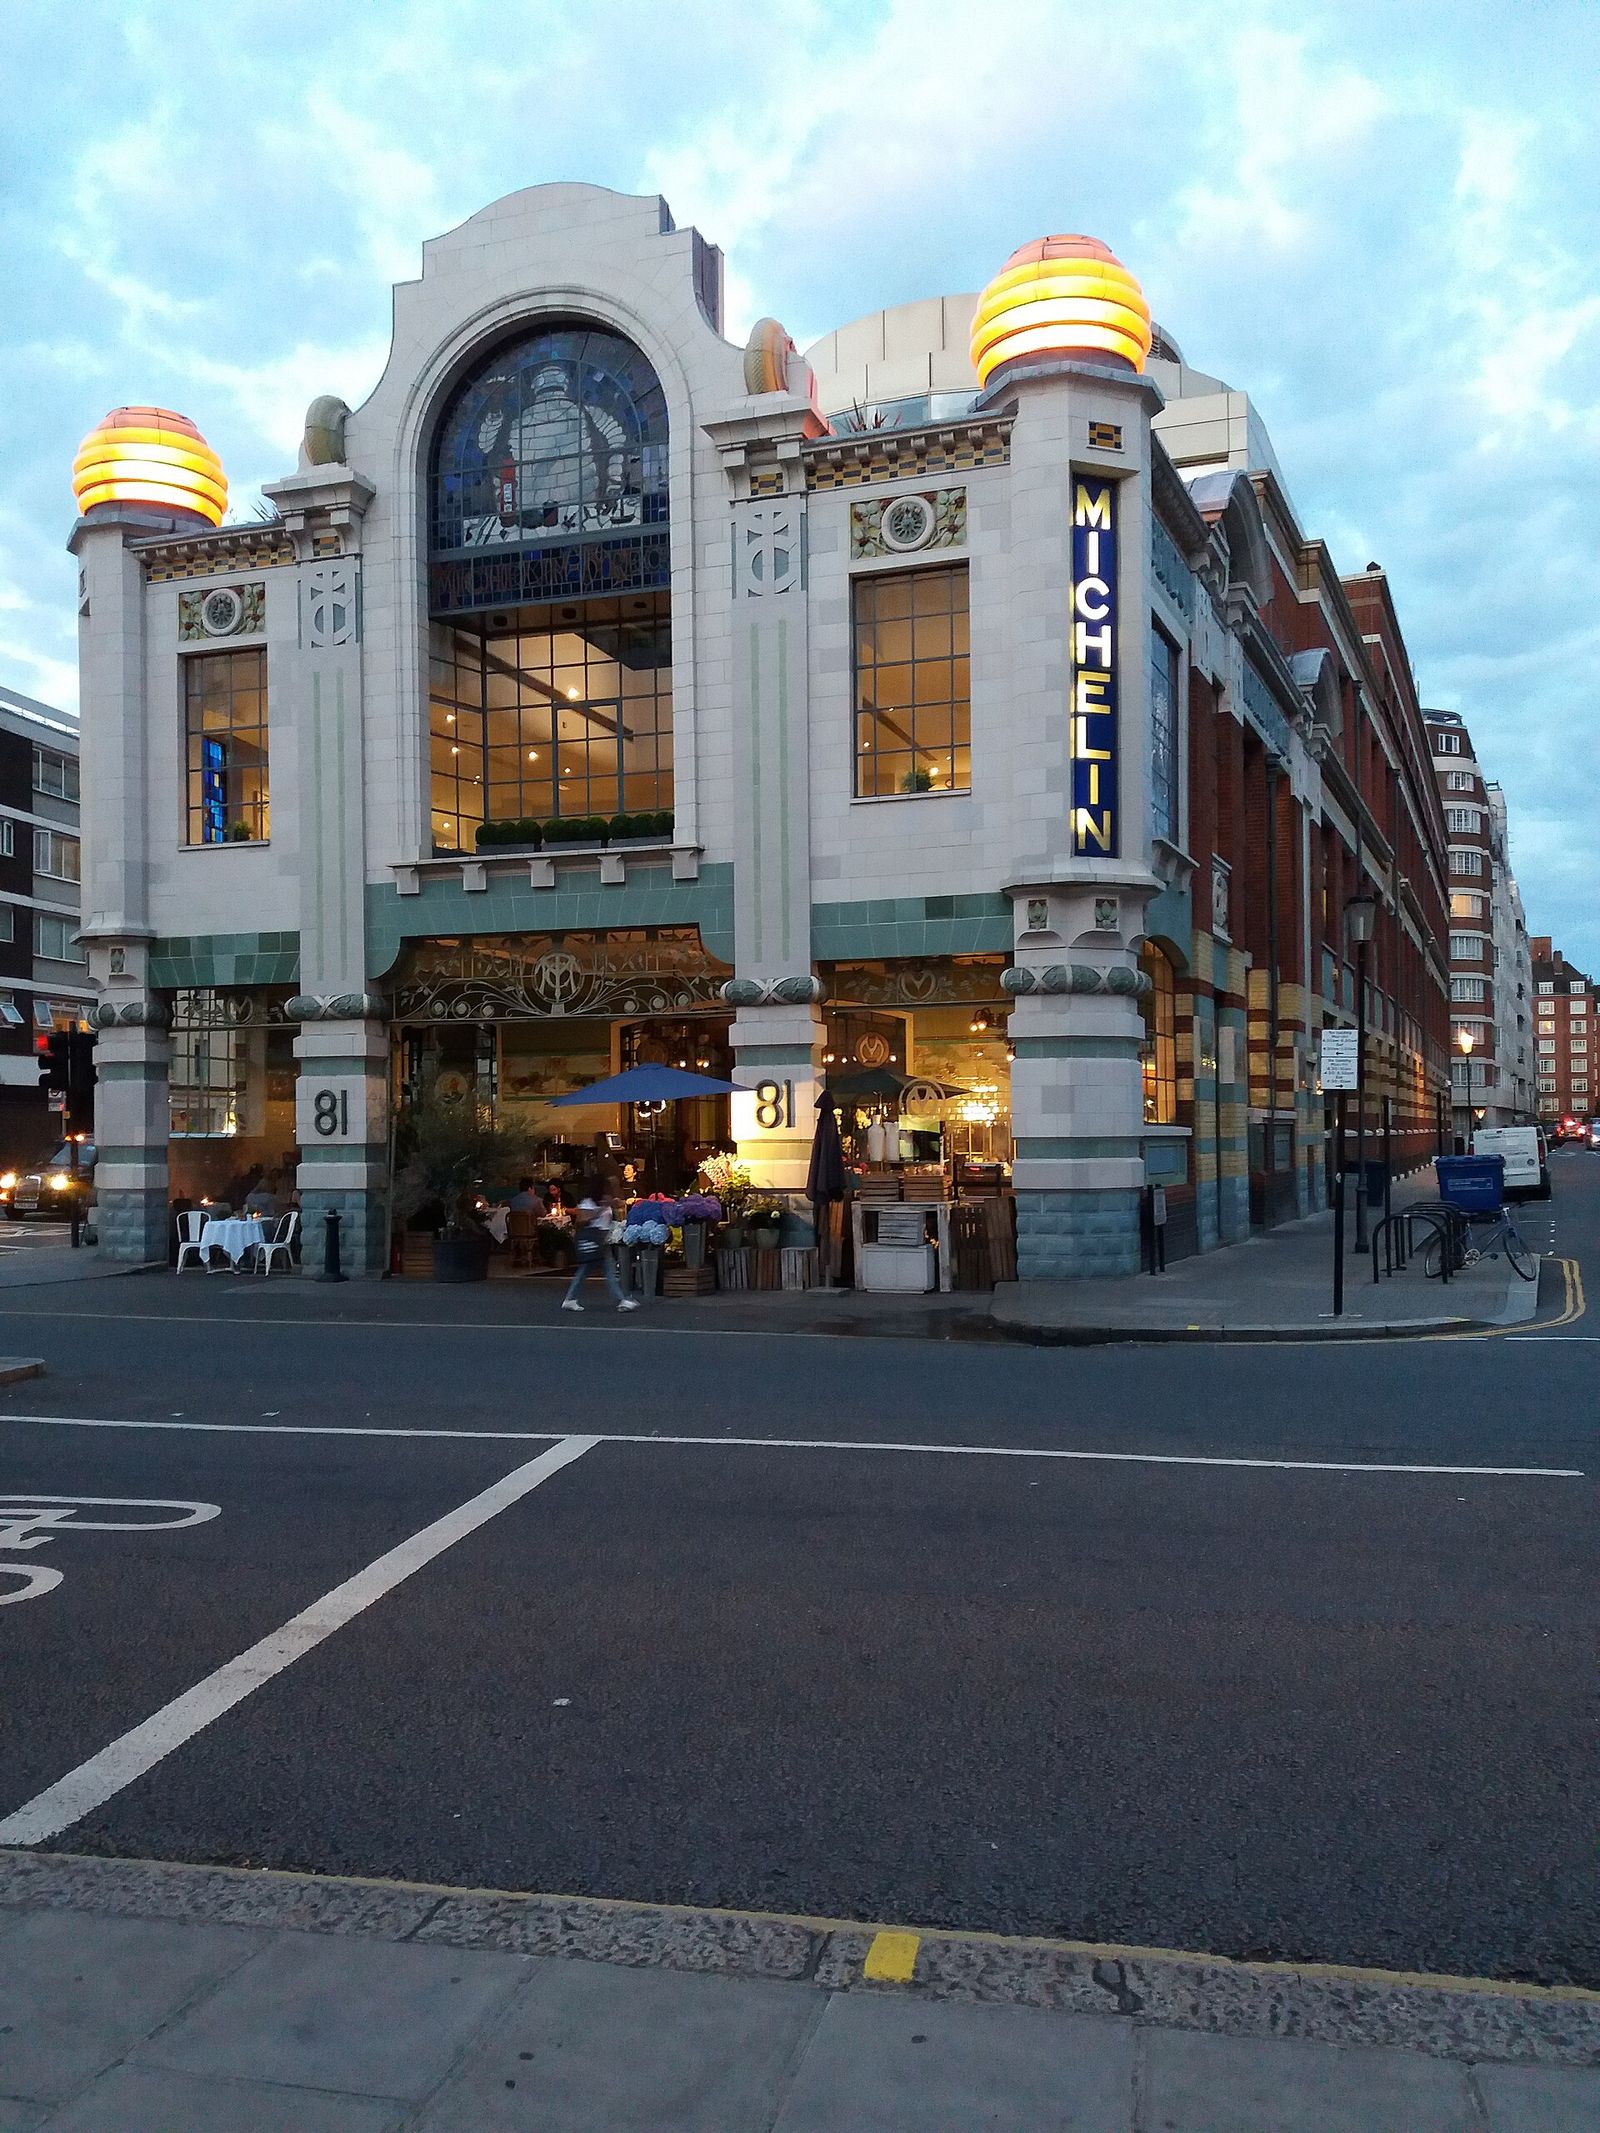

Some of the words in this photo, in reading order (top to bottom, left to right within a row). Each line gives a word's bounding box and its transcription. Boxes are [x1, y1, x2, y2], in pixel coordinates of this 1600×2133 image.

[1075, 484, 1112, 852] MICHELIN
[314, 1089, 348, 1136] 81
[756, 1079, 796, 1129] 81
